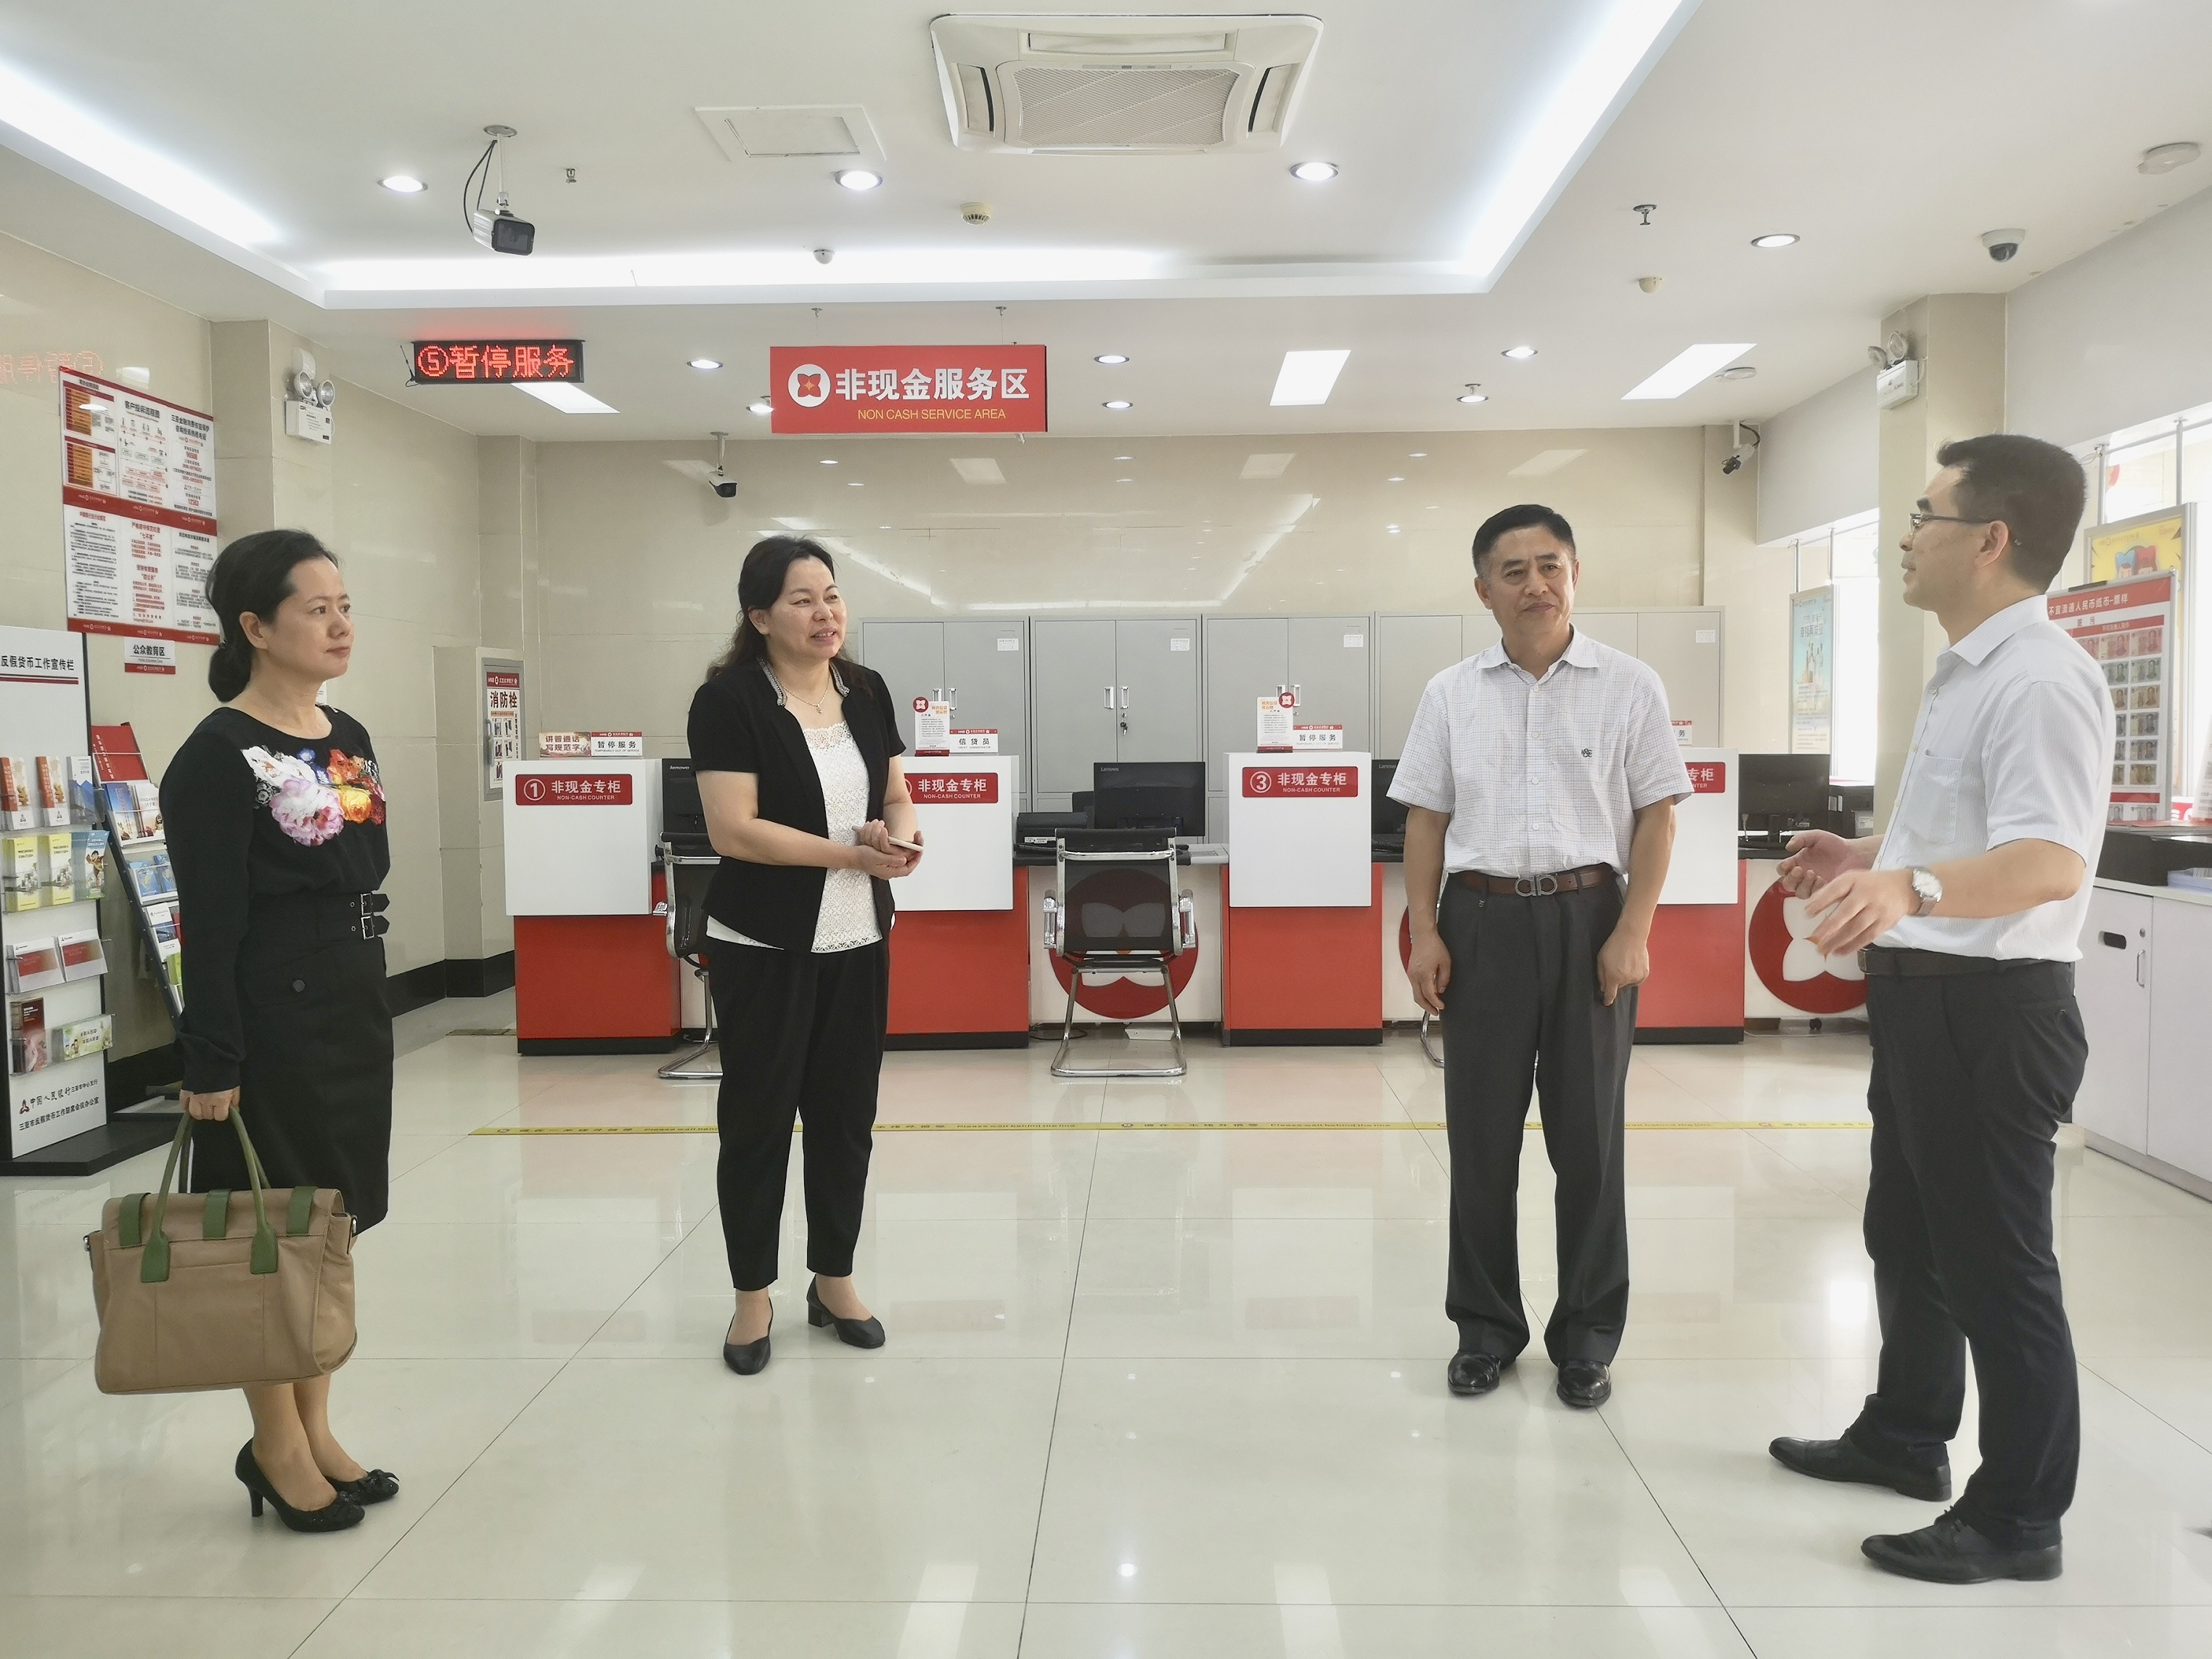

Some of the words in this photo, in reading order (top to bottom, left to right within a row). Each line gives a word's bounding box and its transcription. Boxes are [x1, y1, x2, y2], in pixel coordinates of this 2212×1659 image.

[835, 367, 1030, 401] 非现金服务区
[857, 409, 883, 420] NON
[886, 409, 918, 420] CASH
[921, 409, 972, 420] SERVICE
[974, 409, 1006, 420] AREA
[133, 644, 165, 657] 公众教育区
[1, 655, 74, 671] 反假货币工作宣传栏
[490, 691, 517, 708] 消防栓
[917, 778, 987, 792] 非现金专柜
[1277, 772, 1347, 786] 非现金专柜
[551, 780, 621, 794] 非现金专柜
